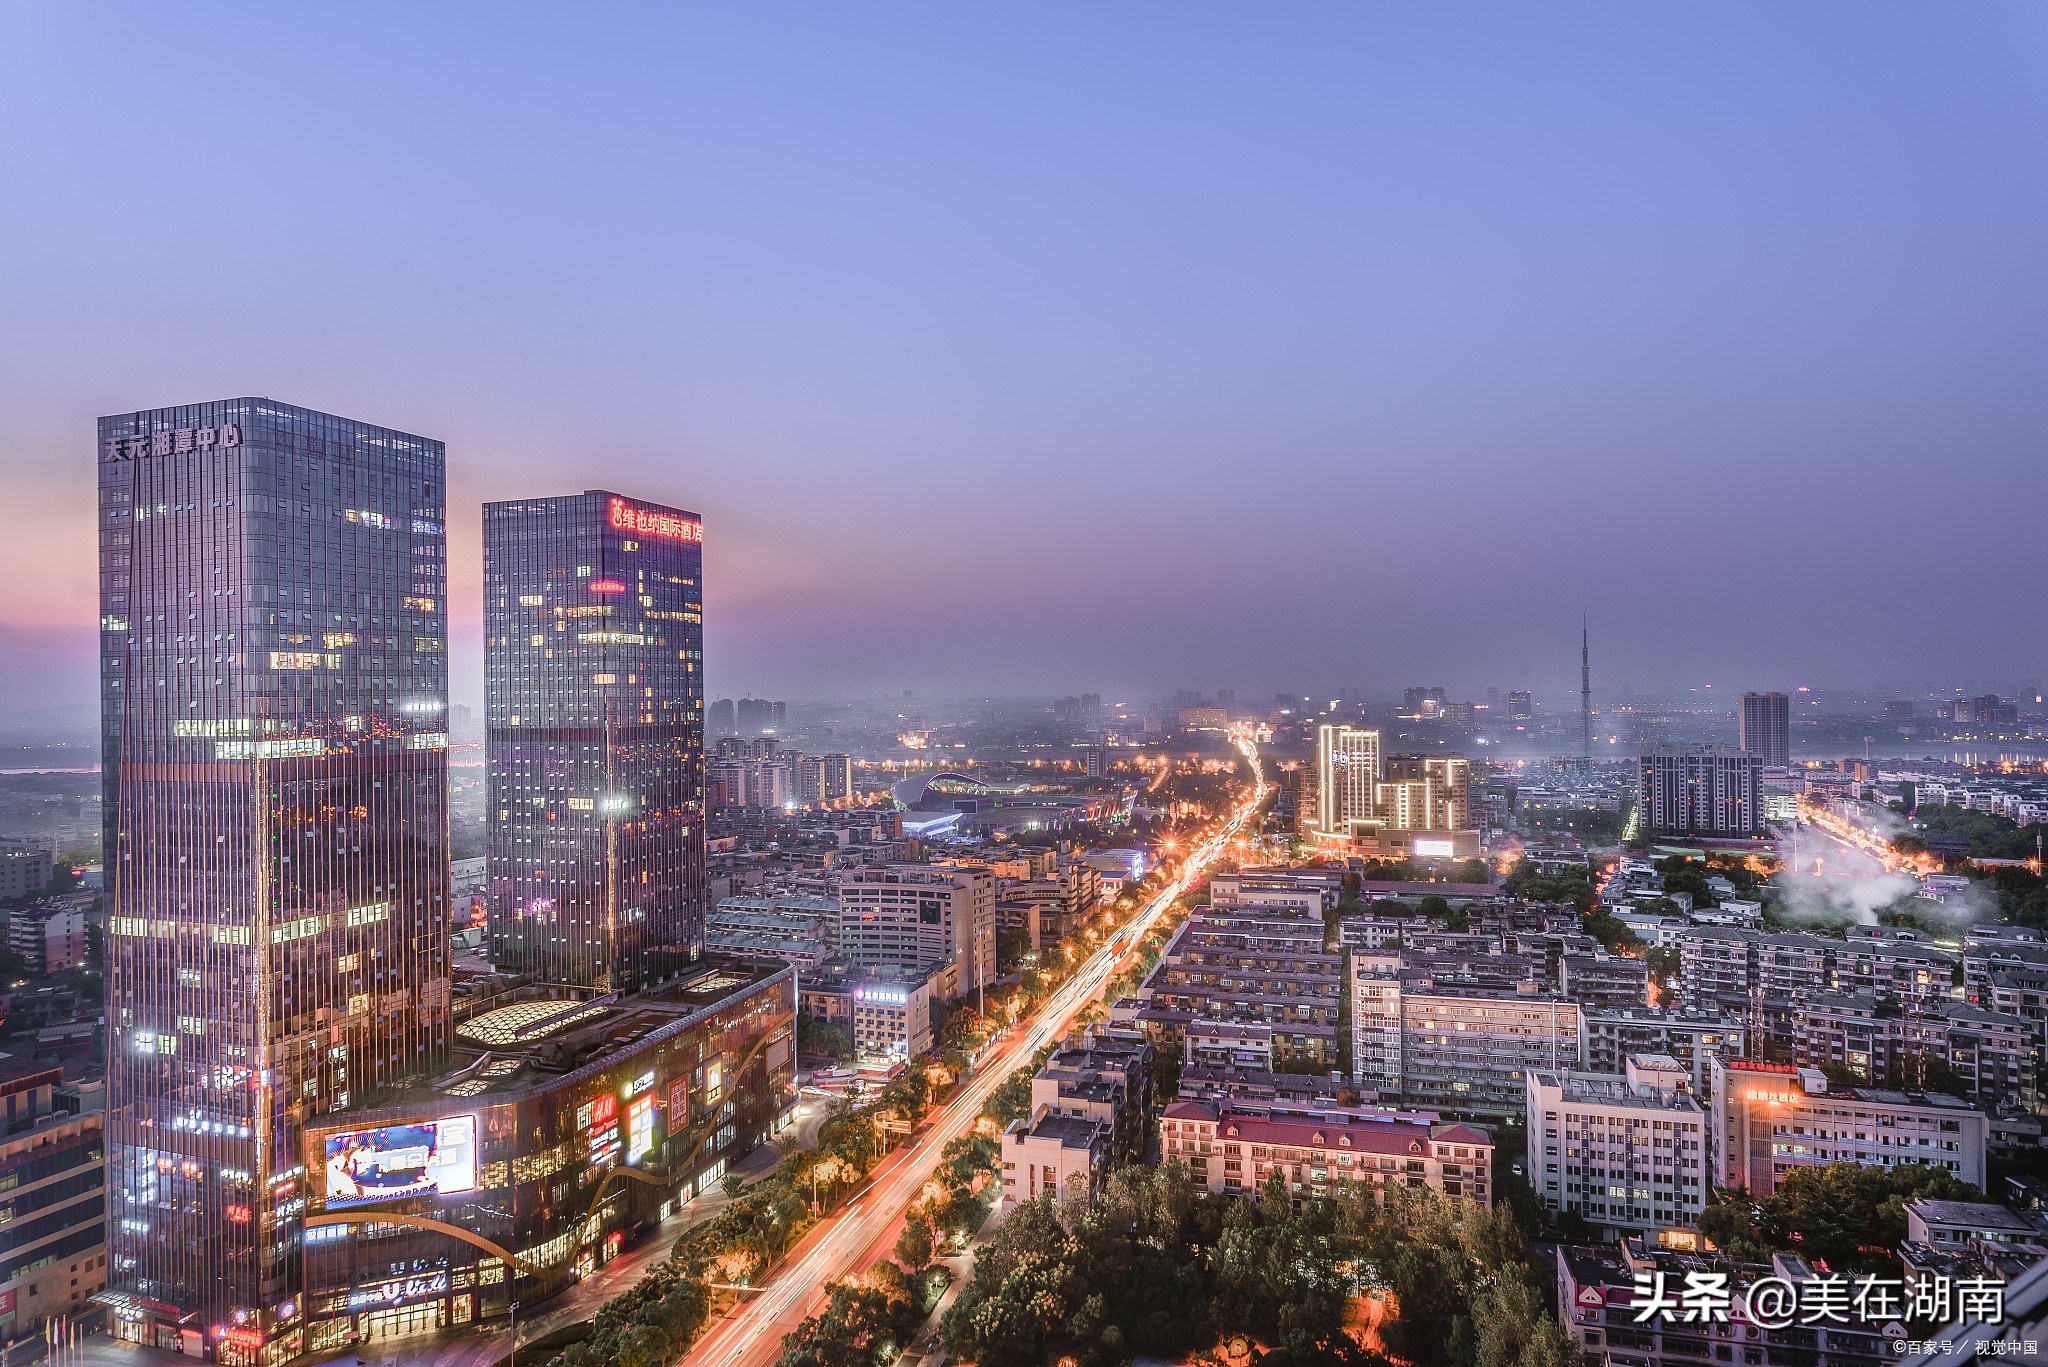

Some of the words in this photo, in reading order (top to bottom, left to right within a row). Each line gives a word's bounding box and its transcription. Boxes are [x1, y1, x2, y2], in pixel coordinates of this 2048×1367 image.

[104, 424, 240, 462] 天元湘潭中心
[623, 508, 704, 542] 维也纳国际酒店
